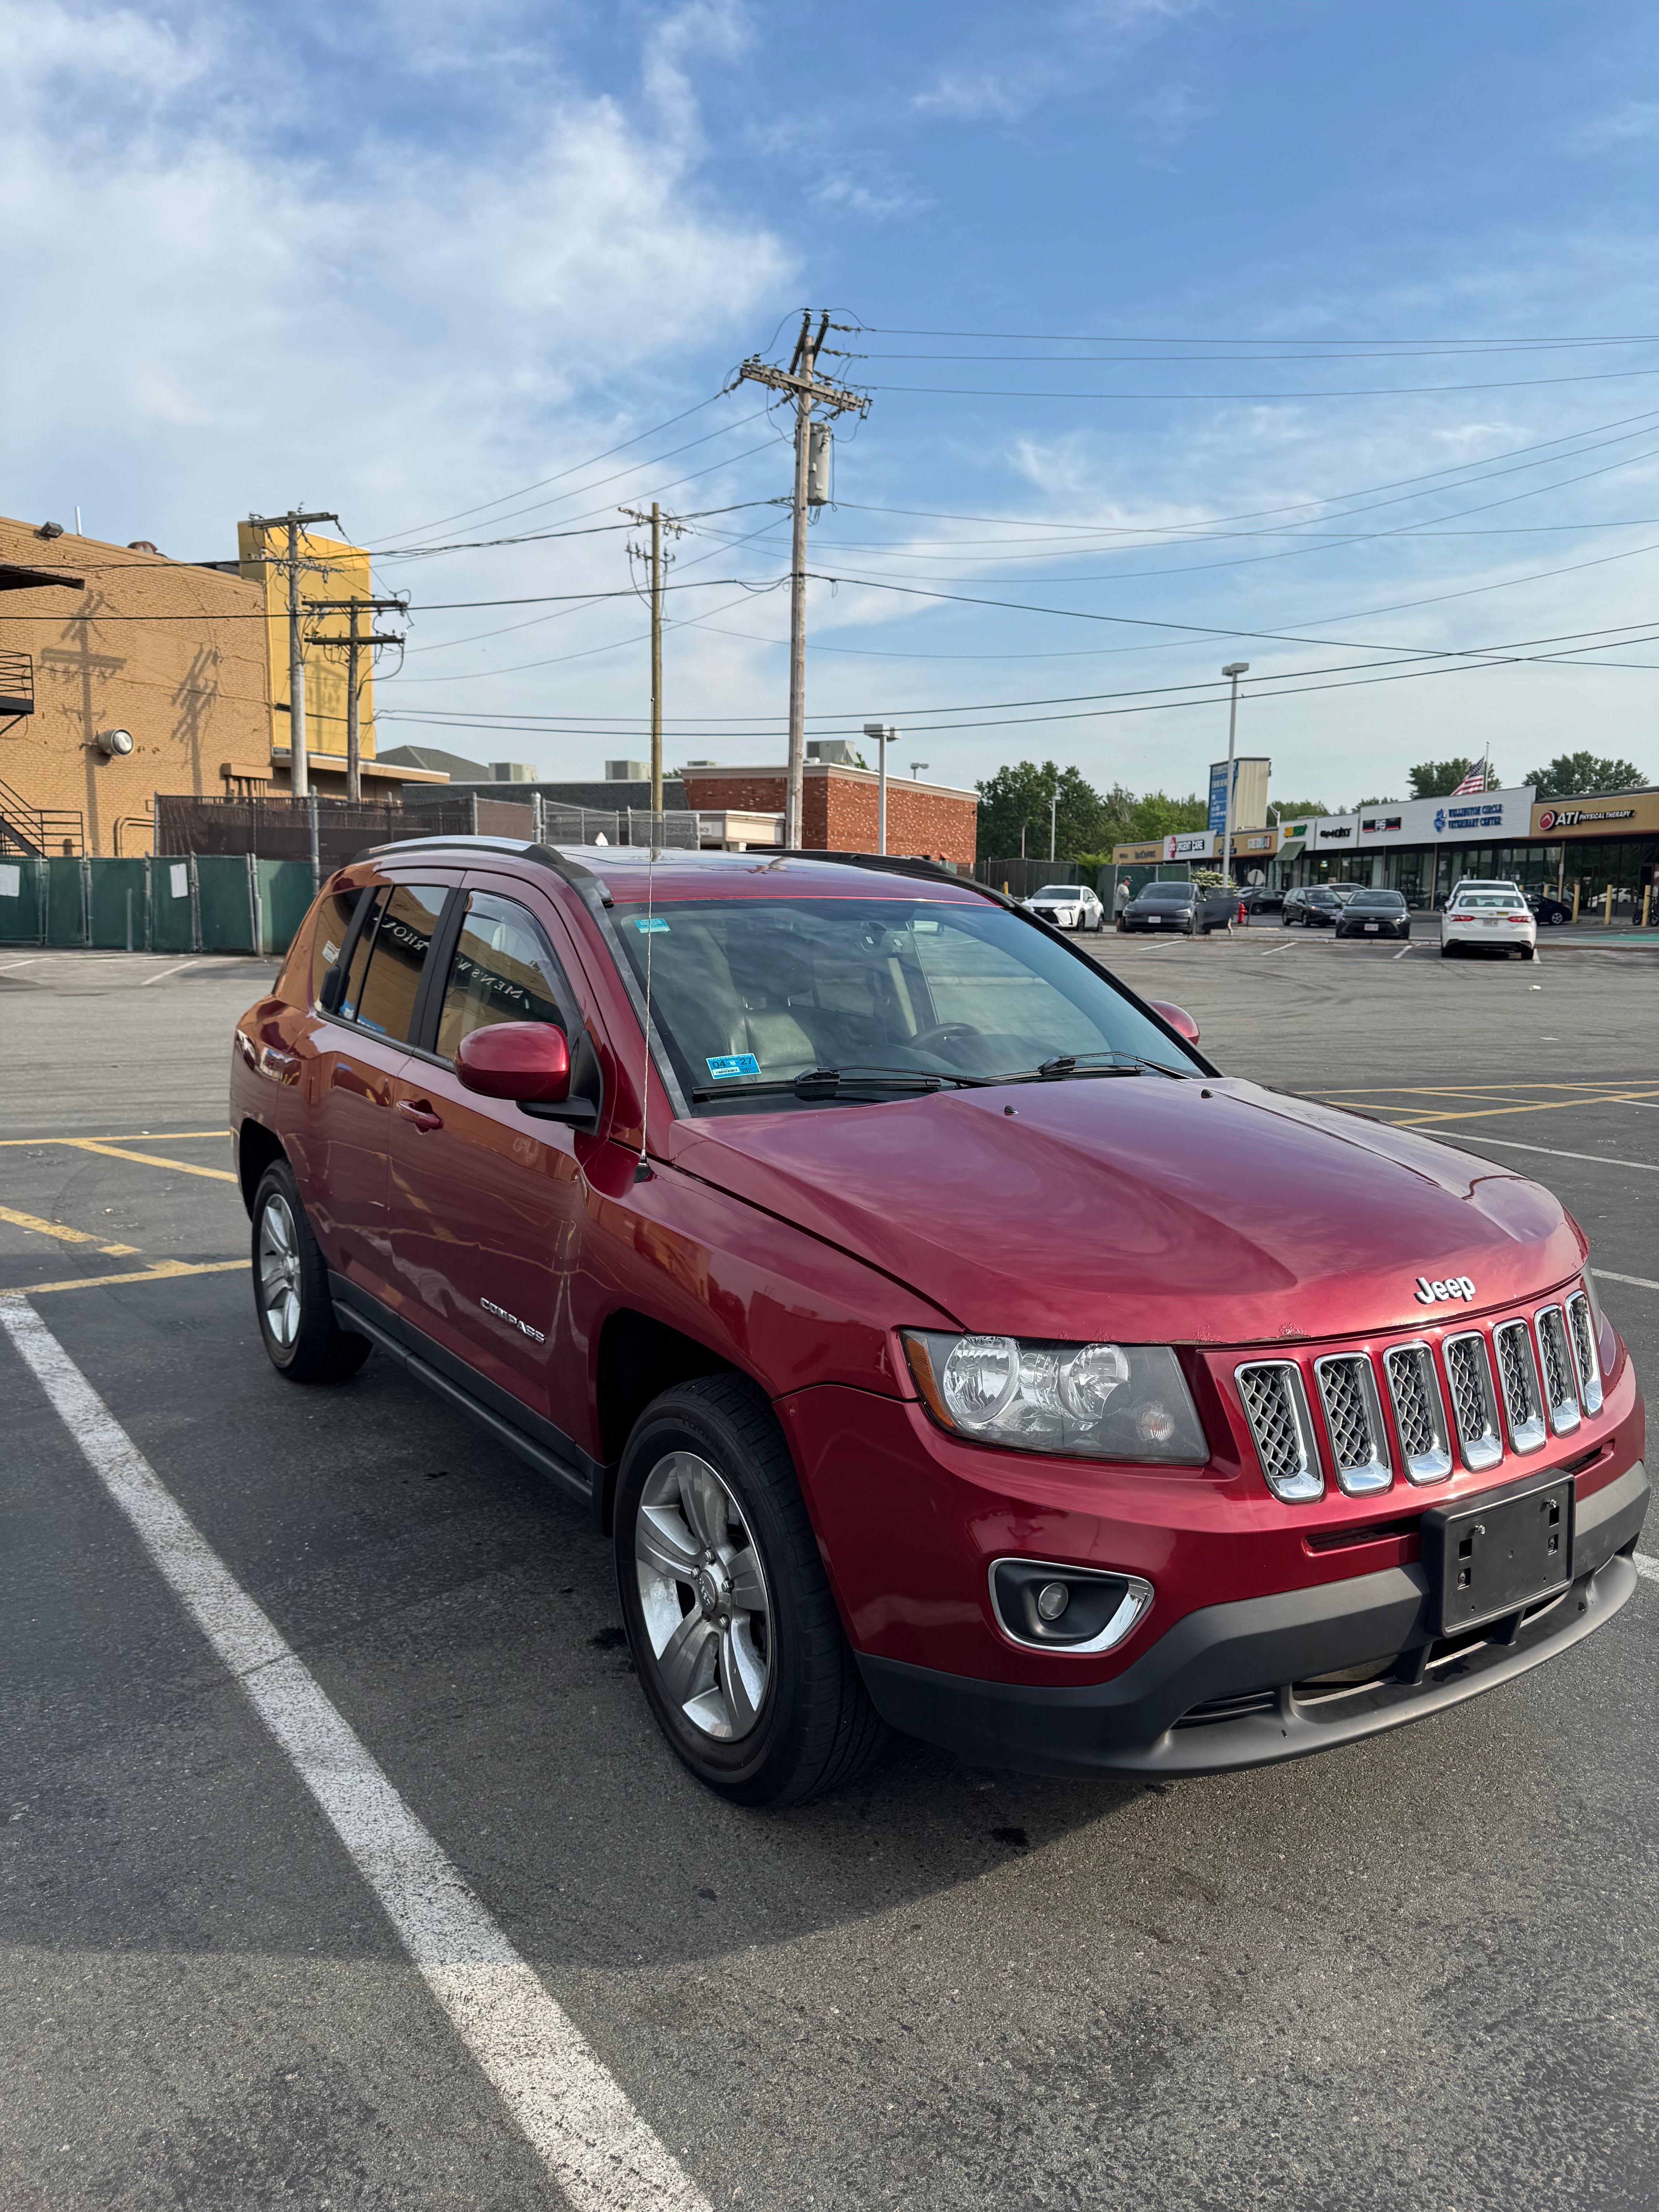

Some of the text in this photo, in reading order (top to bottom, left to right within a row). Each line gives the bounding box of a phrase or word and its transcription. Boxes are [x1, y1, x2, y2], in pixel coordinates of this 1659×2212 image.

[1554, 811, 1579, 826] ATI
[1605, 810, 1630, 819] THERAPY
[1176, 842, 1192, 852] URGENT
[1192, 840, 1204, 851] CARE
[712, 1060, 726, 1068] 04
[1413, 1276, 1476, 1305] Jeep
[480, 1297, 546, 1344] COMPASS
